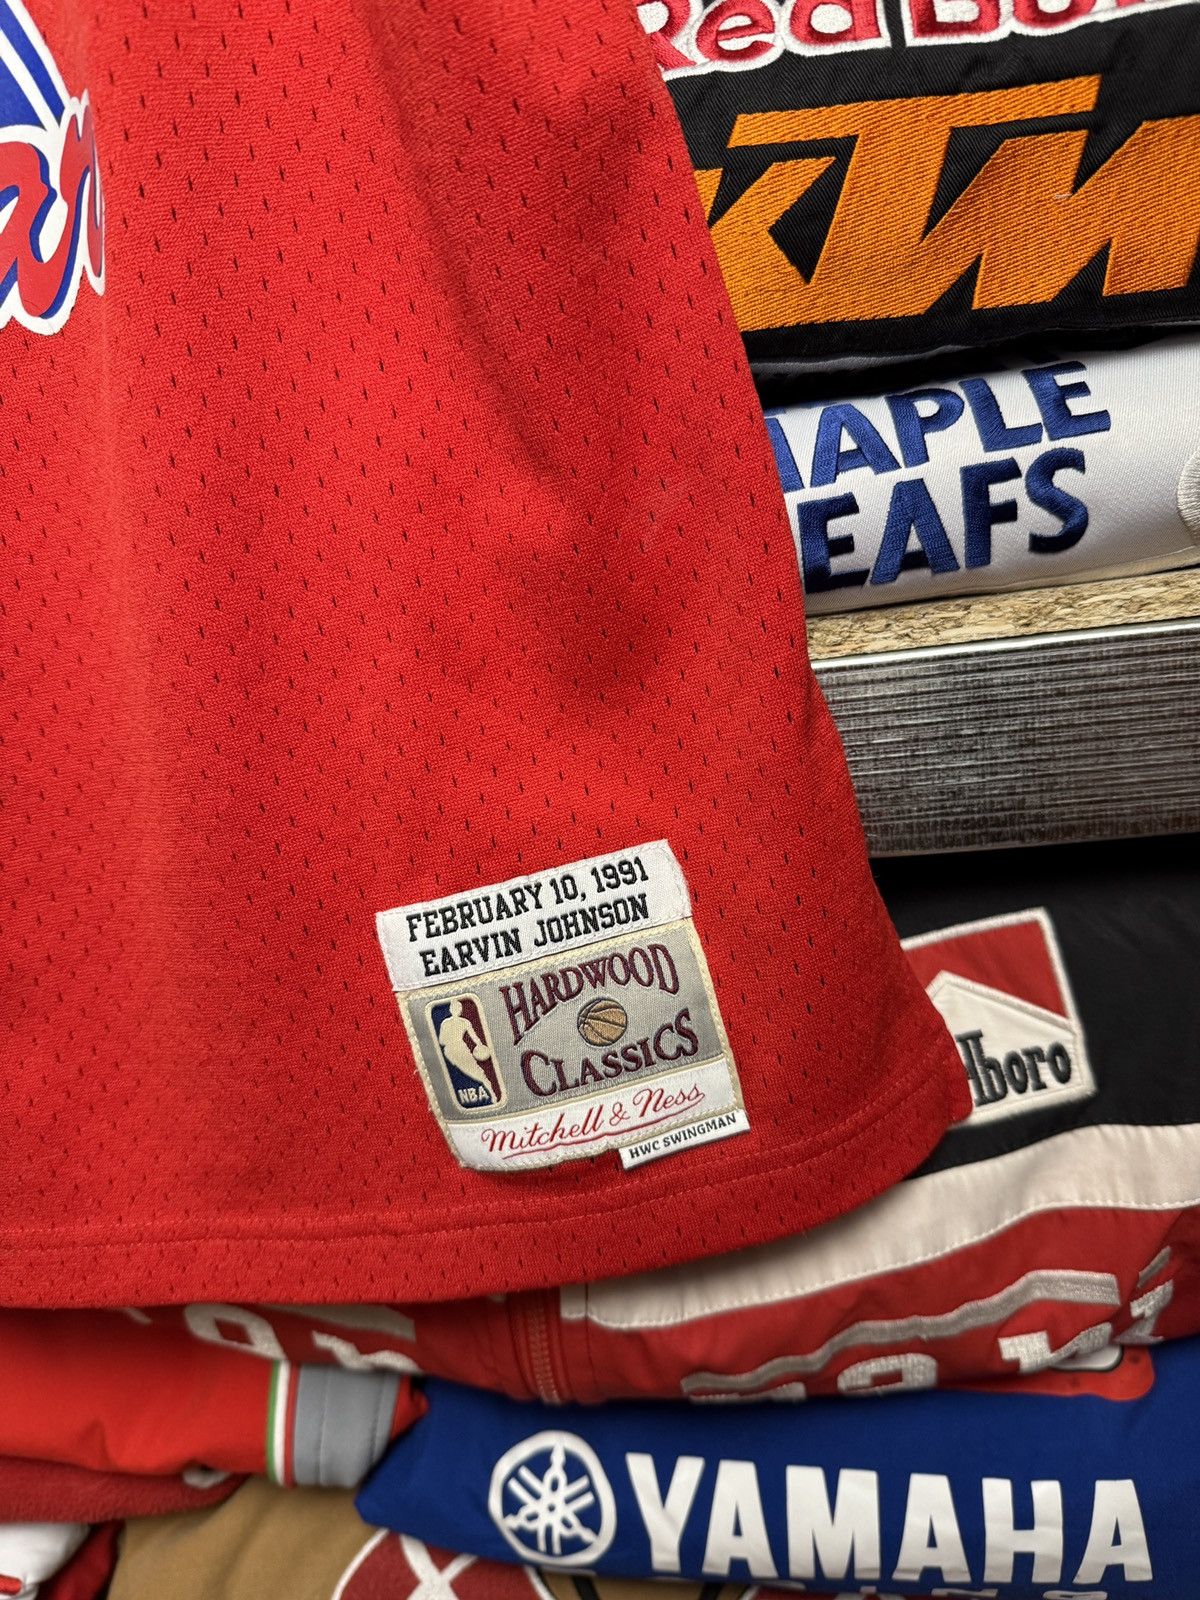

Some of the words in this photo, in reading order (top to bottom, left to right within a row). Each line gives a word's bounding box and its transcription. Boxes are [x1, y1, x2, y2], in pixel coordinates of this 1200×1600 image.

[694, 75, 1200, 331] KTM
[797, 447, 1089, 594] EAFS
[406, 883, 543, 943] FEBRUARY
[550, 874, 586, 903] 10,
[590, 855, 650, 893] 1991
[420, 928, 522, 977] EARVIN
[533, 893, 650, 949] JOHNSON
[499, 943, 681, 1046] HARDWOOD
[457, 1087, 489, 1105] NBA
[520, 1007, 700, 1098] CLASSICS
[954, 1029, 1073, 1108] lboro
[481, 1105, 603, 1152] Mitchell
[609, 1102, 630, 1126] &
[633, 1084, 705, 1118] Ness
[629, 1139, 661, 1160] HWC
[663, 1112, 737, 1148] SWINGMAN
[626, 1452, 1154, 1584] YAMAHA
